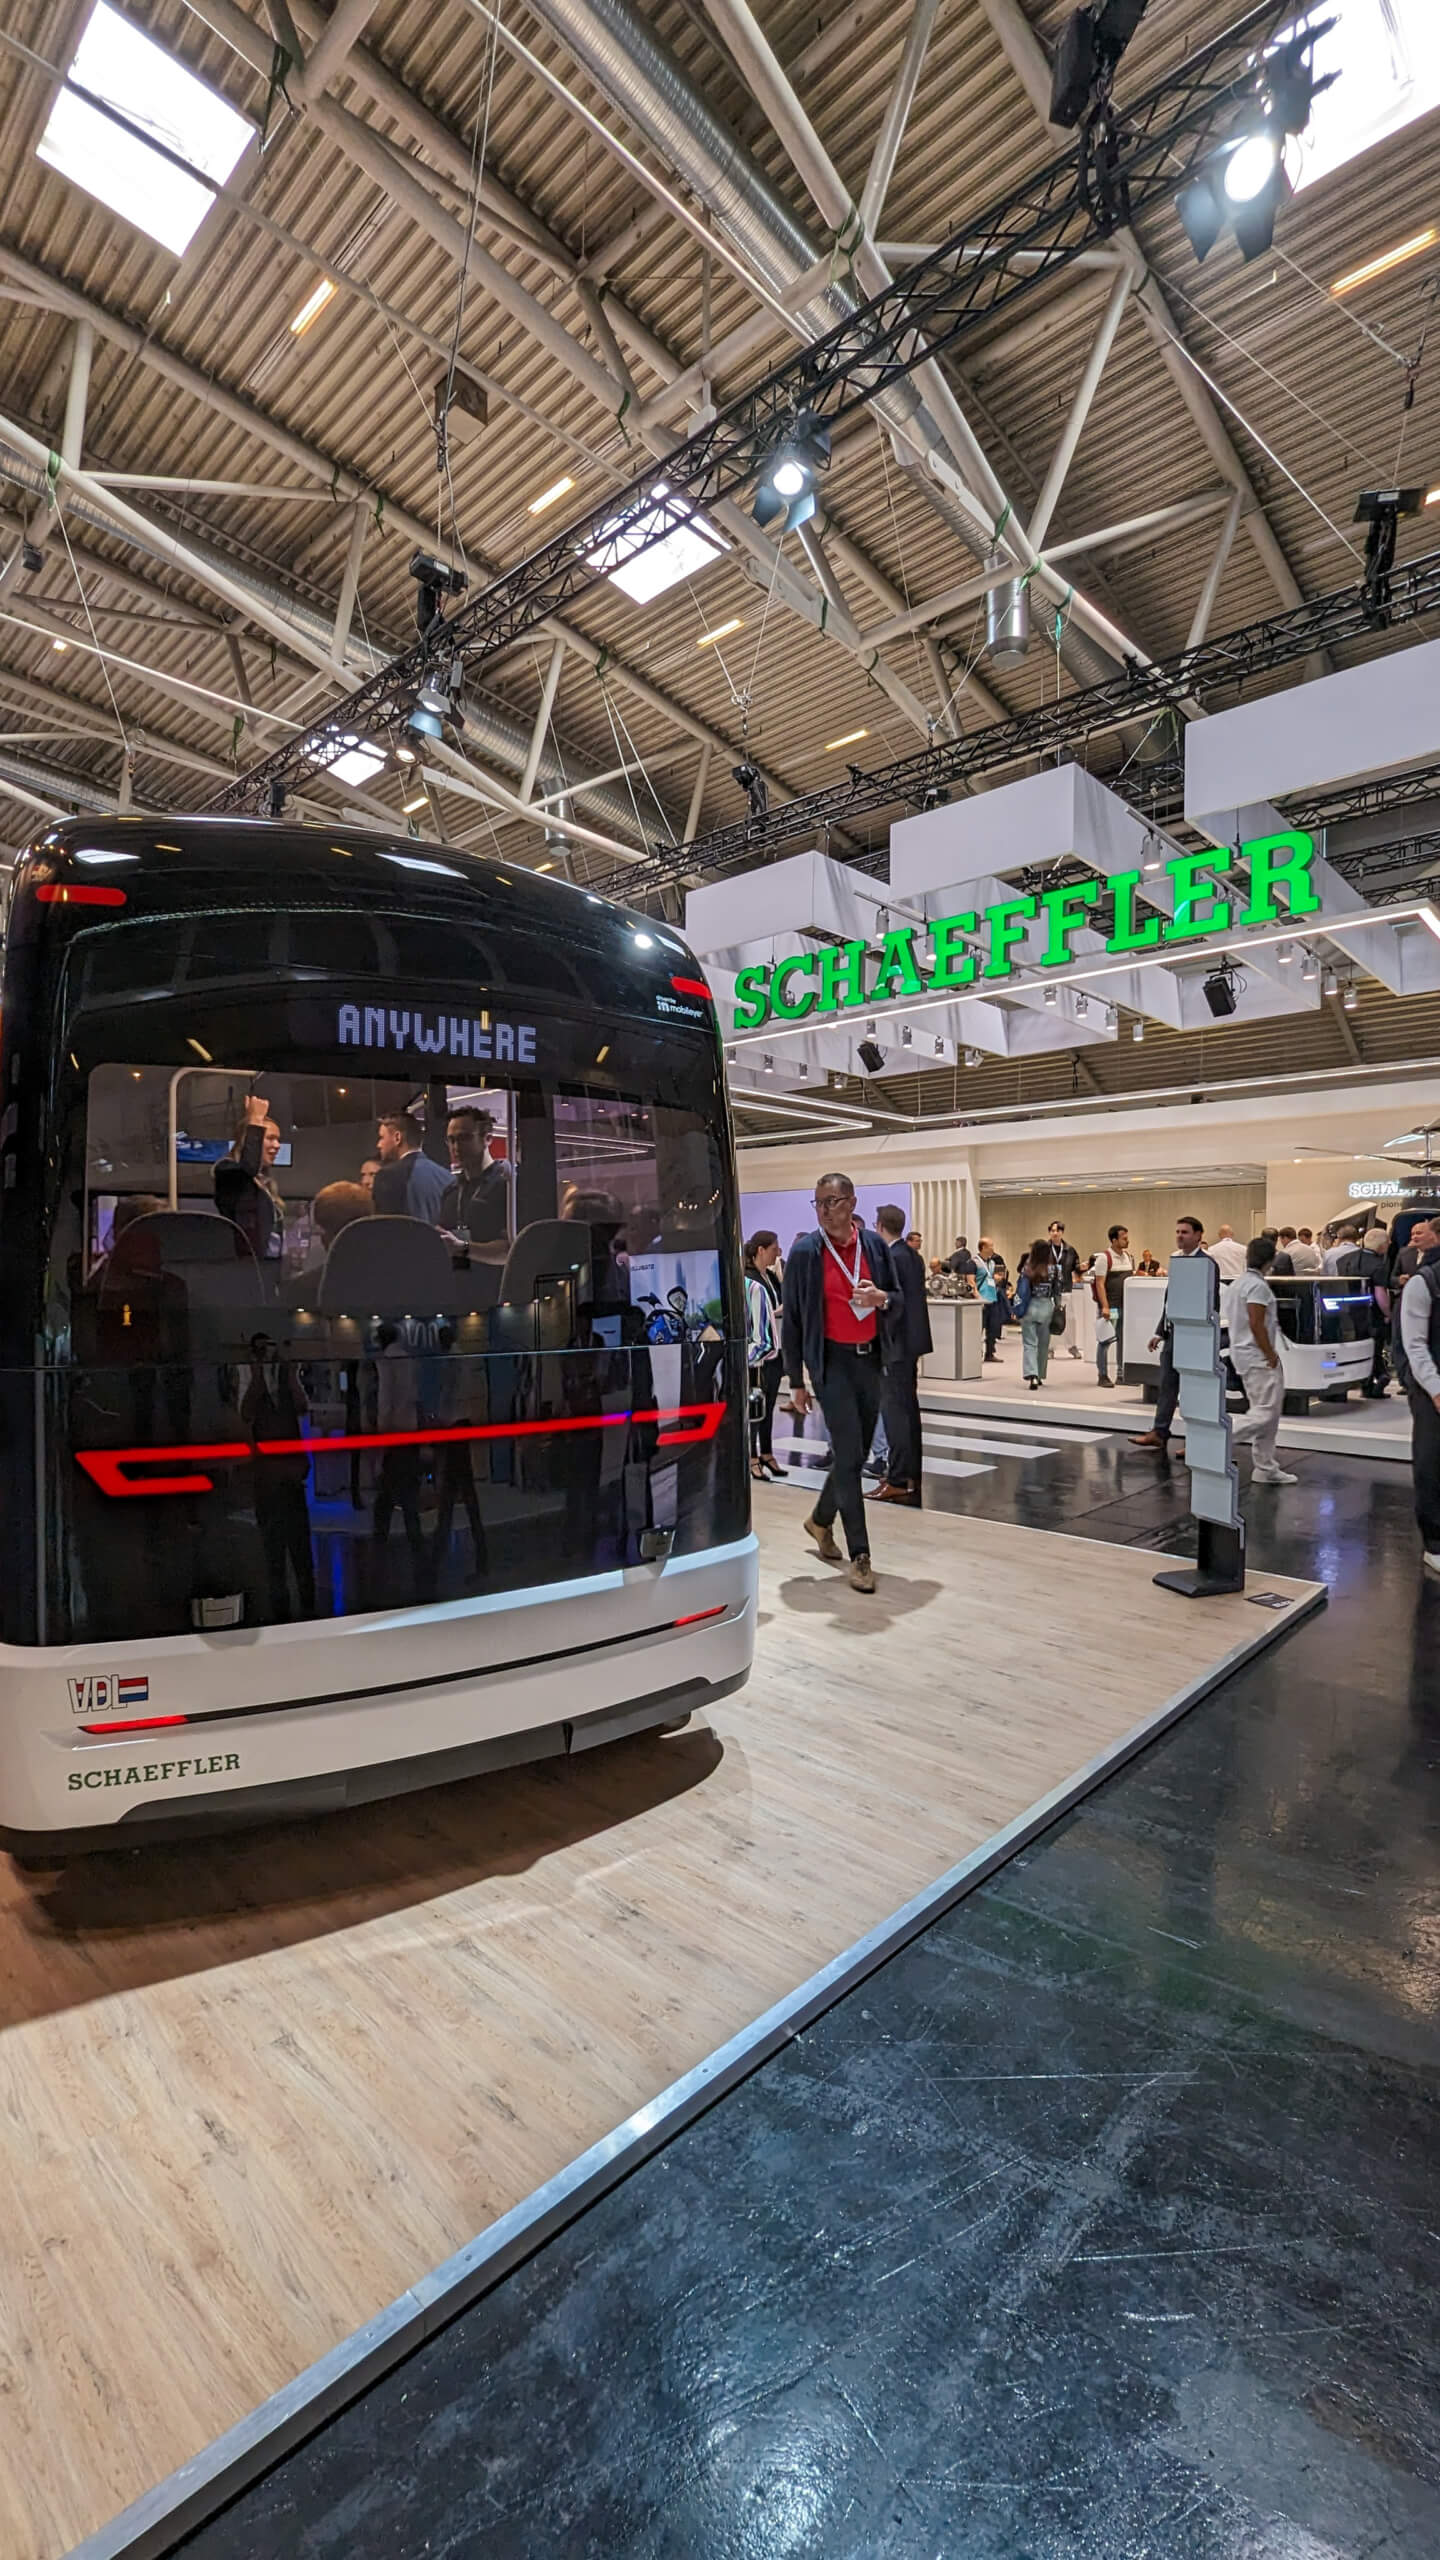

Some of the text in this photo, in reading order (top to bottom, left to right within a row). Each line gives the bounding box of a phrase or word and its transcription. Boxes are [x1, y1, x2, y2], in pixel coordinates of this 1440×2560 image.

[733, 830, 1321, 1030] SCHAEFFLER
[338, 1004, 536, 1064] ANYWHERE
[67, 1673, 128, 1714] VDL
[68, 1753, 240, 1791] SCHAEFFLER
